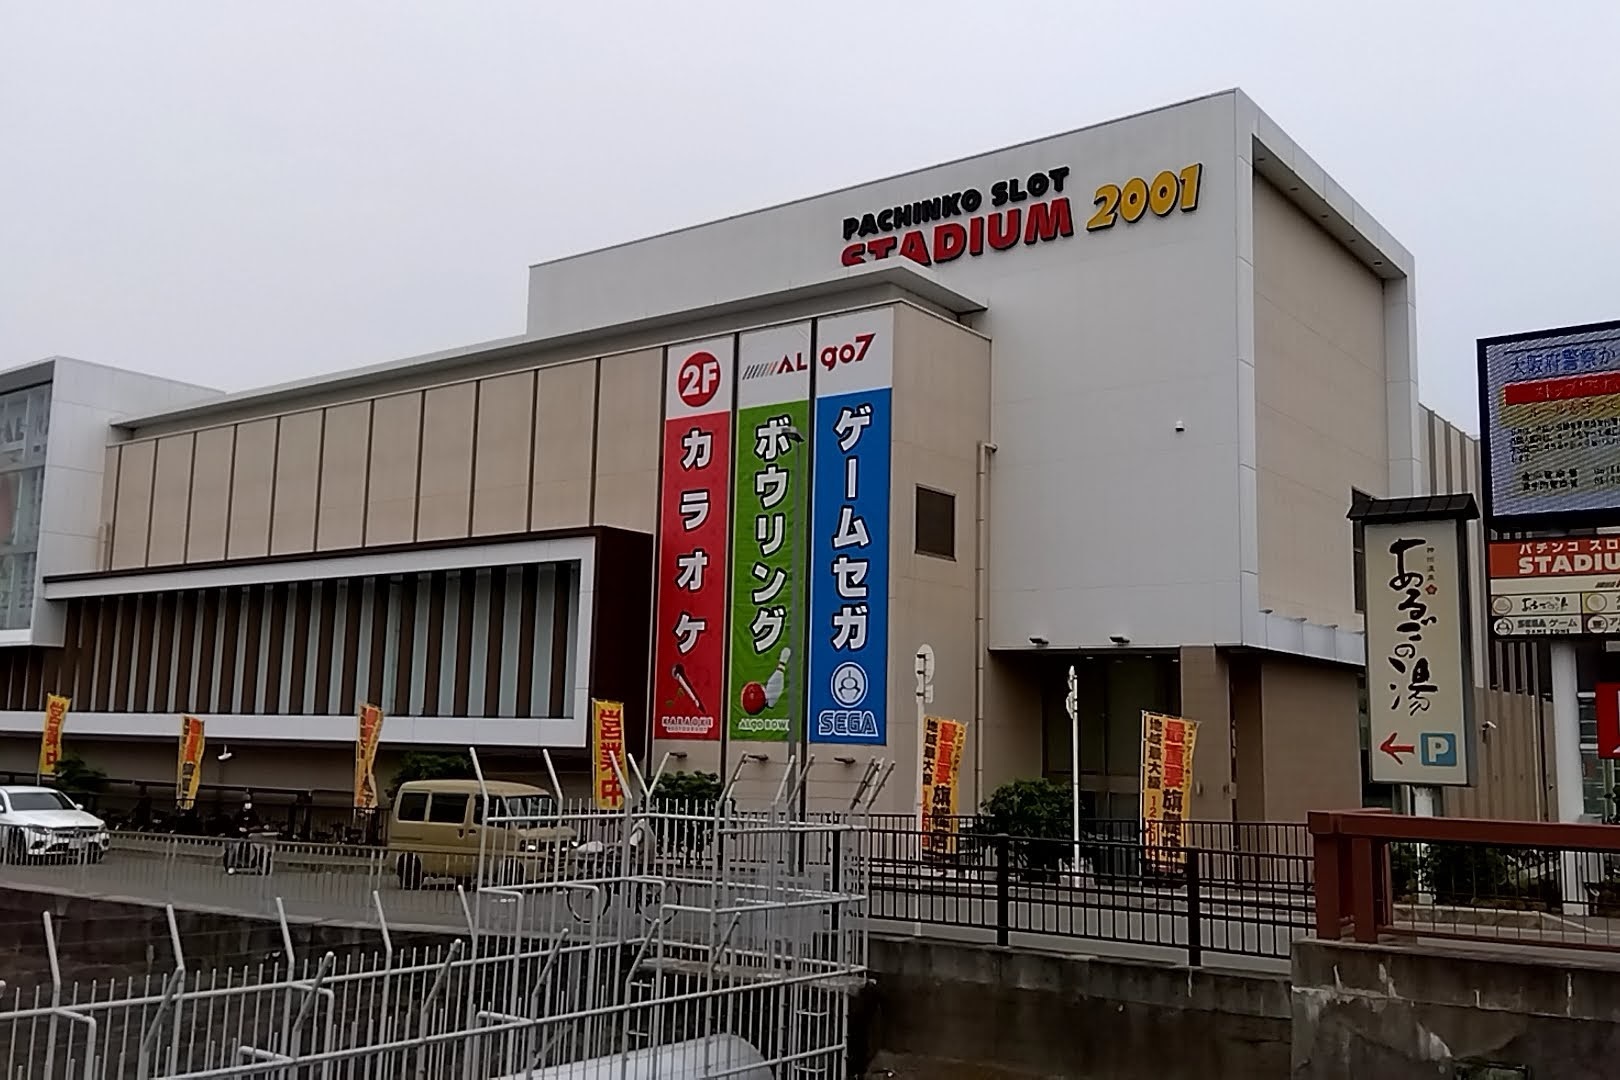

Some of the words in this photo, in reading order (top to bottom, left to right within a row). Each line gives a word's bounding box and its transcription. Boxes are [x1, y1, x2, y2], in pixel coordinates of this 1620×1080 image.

[841, 197, 1074, 268] STADIUM
[843, 188, 982, 240] PACHINKO
[992, 166, 1070, 206] SLOT
[1086, 163, 1202, 232] 2001
[681, 361, 718, 397] 2F
[675, 428, 712, 654] カラオケ
[750, 416, 790, 653] ボウリング
[833, 404, 872, 651] ゲームセガ
[1519, 541, 1579, 554] パチンコ
[600, 709, 624, 807] 営業中
[819, 711, 878, 736] SEGA
[1428, 736, 1449, 763] P
